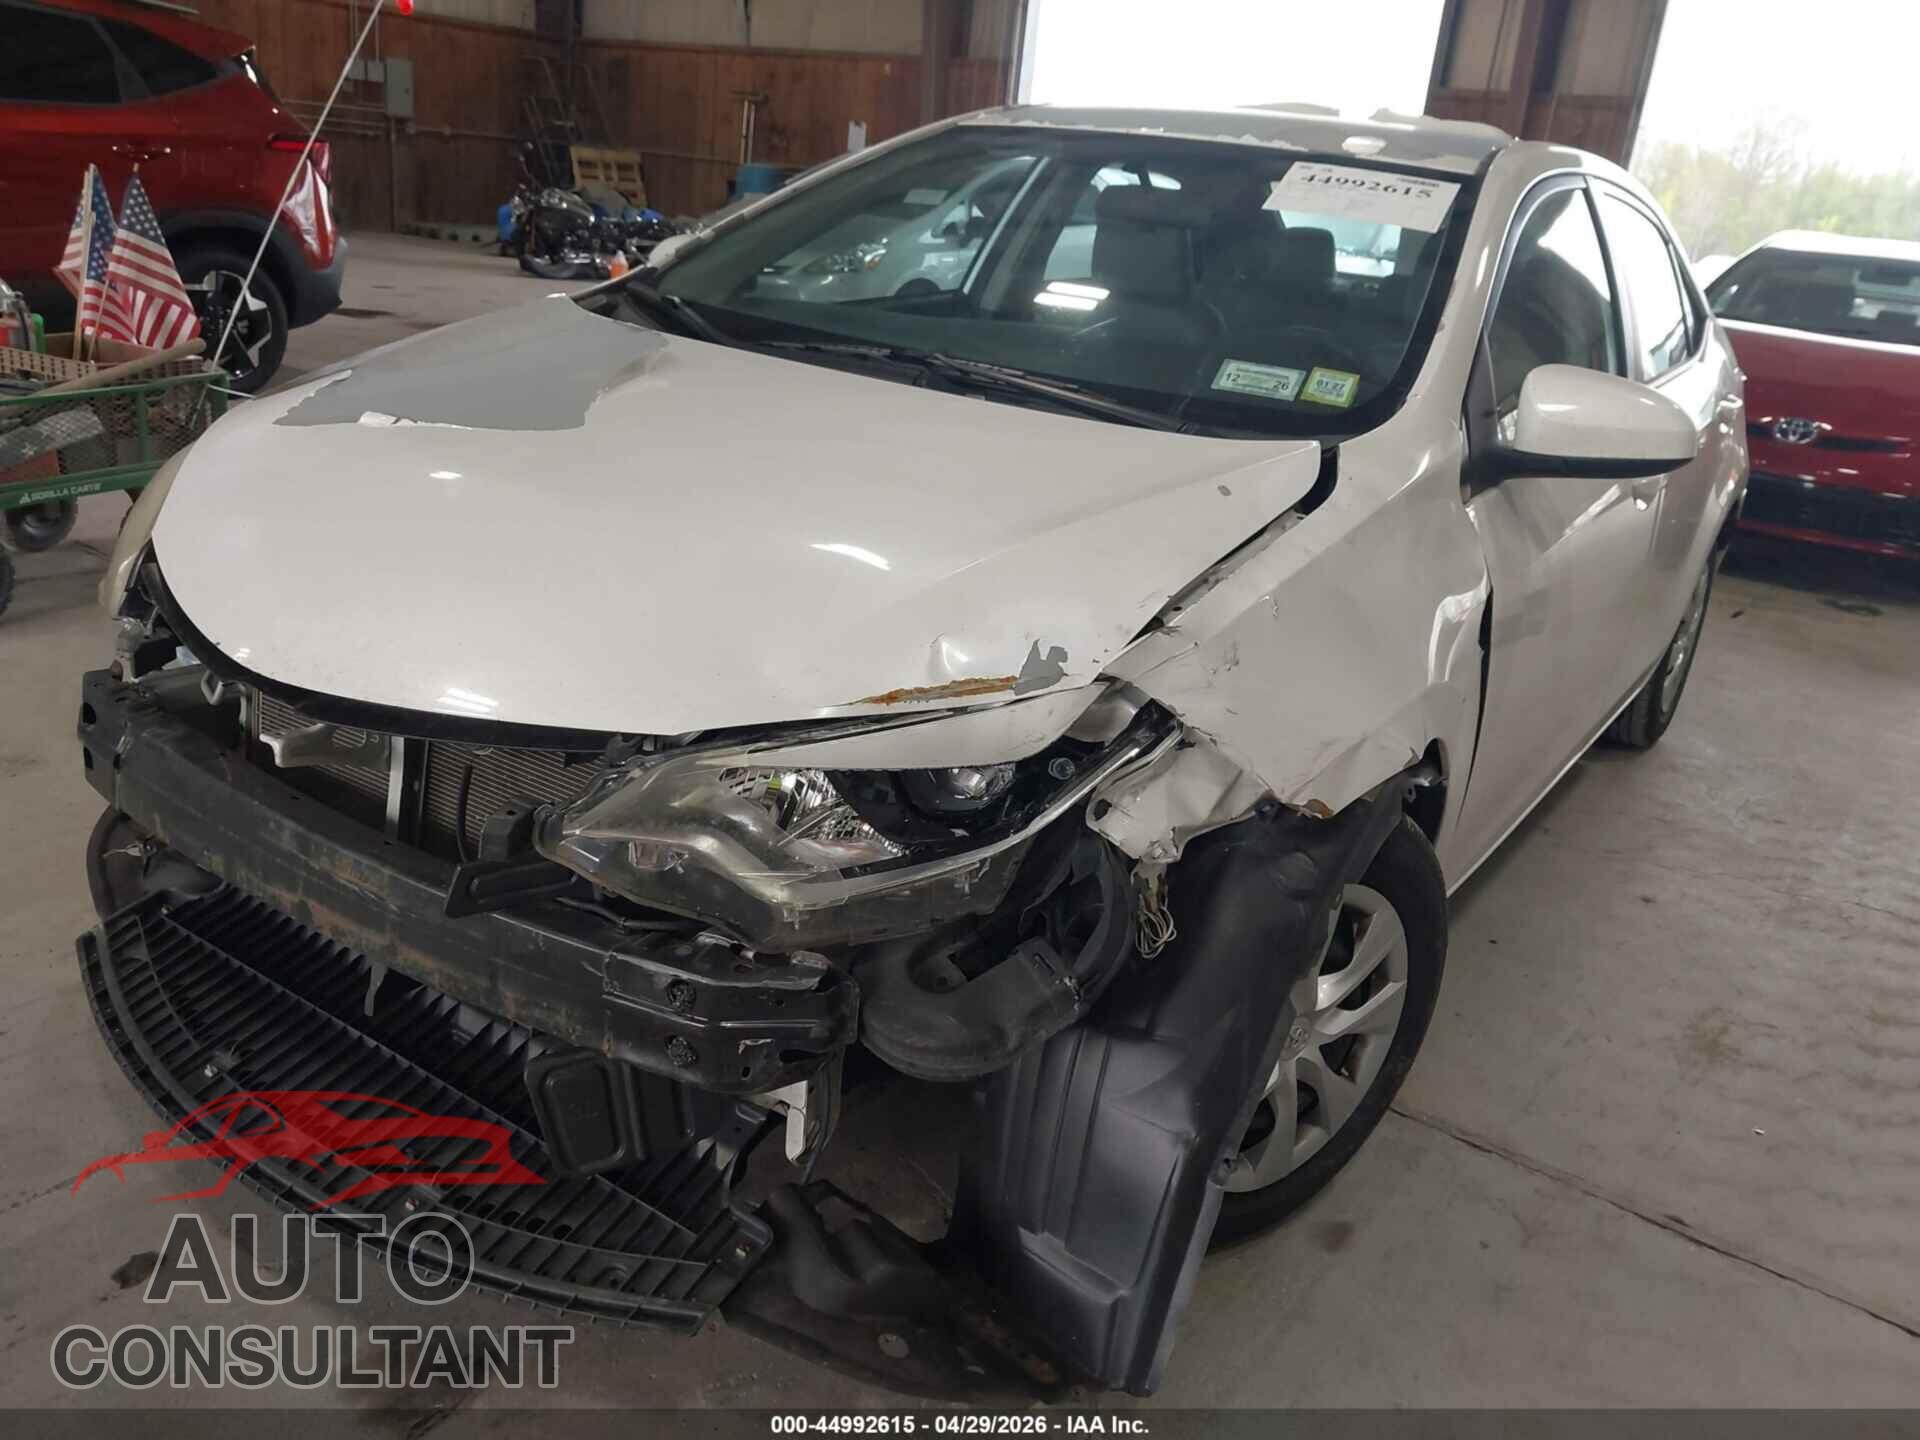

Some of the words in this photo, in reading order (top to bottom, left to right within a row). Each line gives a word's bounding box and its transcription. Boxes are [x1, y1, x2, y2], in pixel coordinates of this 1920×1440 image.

[1301, 174, 1432, 198] 44992615
[1226, 372, 1241, 382] 12
[1273, 381, 1289, 391] 26
